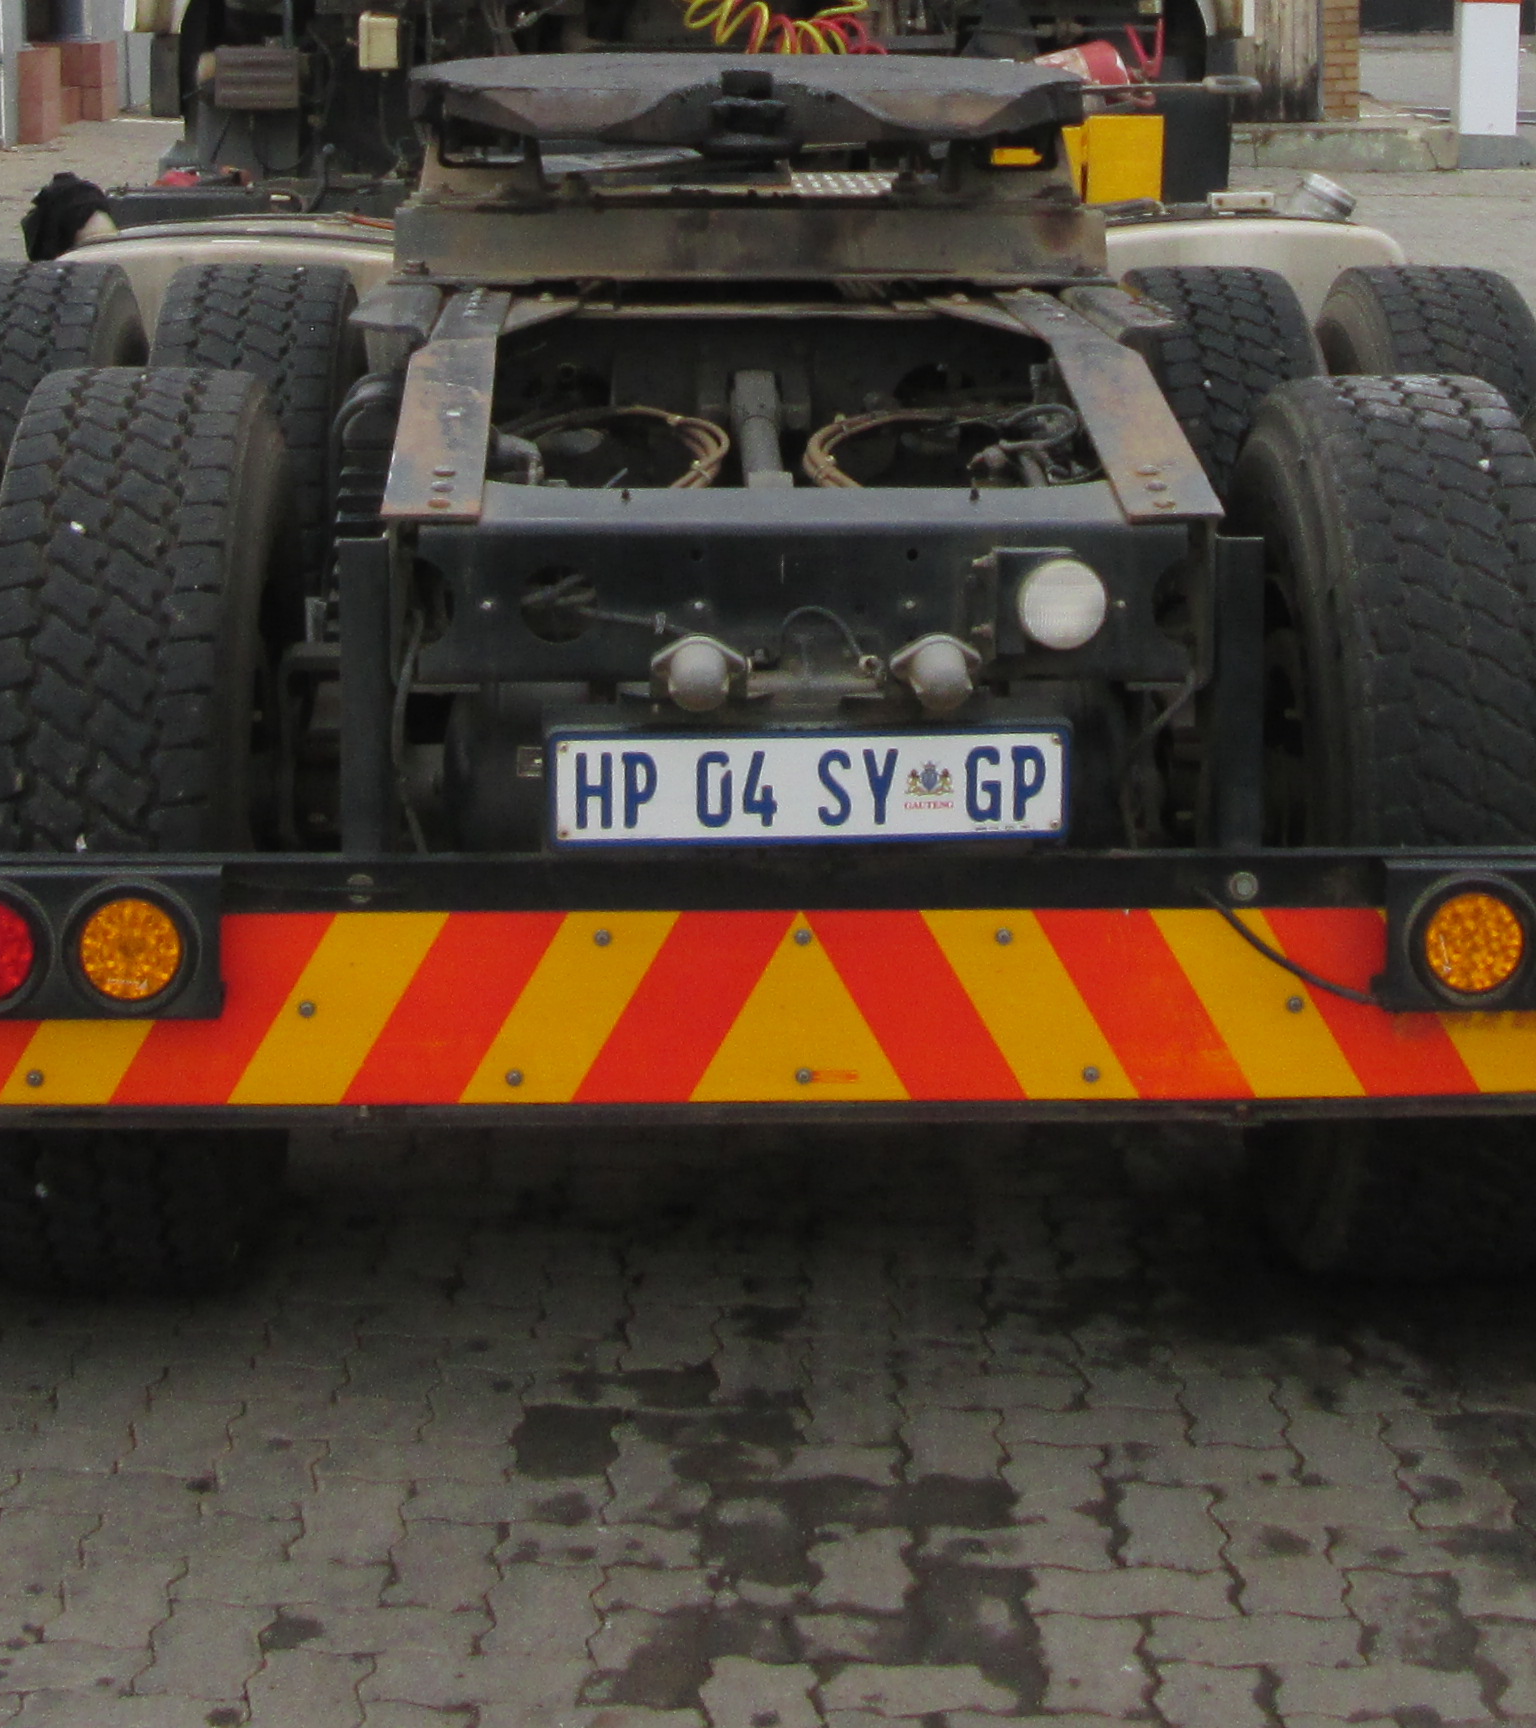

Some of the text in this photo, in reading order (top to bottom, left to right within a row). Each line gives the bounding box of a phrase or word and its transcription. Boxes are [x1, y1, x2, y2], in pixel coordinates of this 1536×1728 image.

[575, 745, 1046, 829] HP 04 SY GP
[904, 800, 954, 810] GAUTENG
